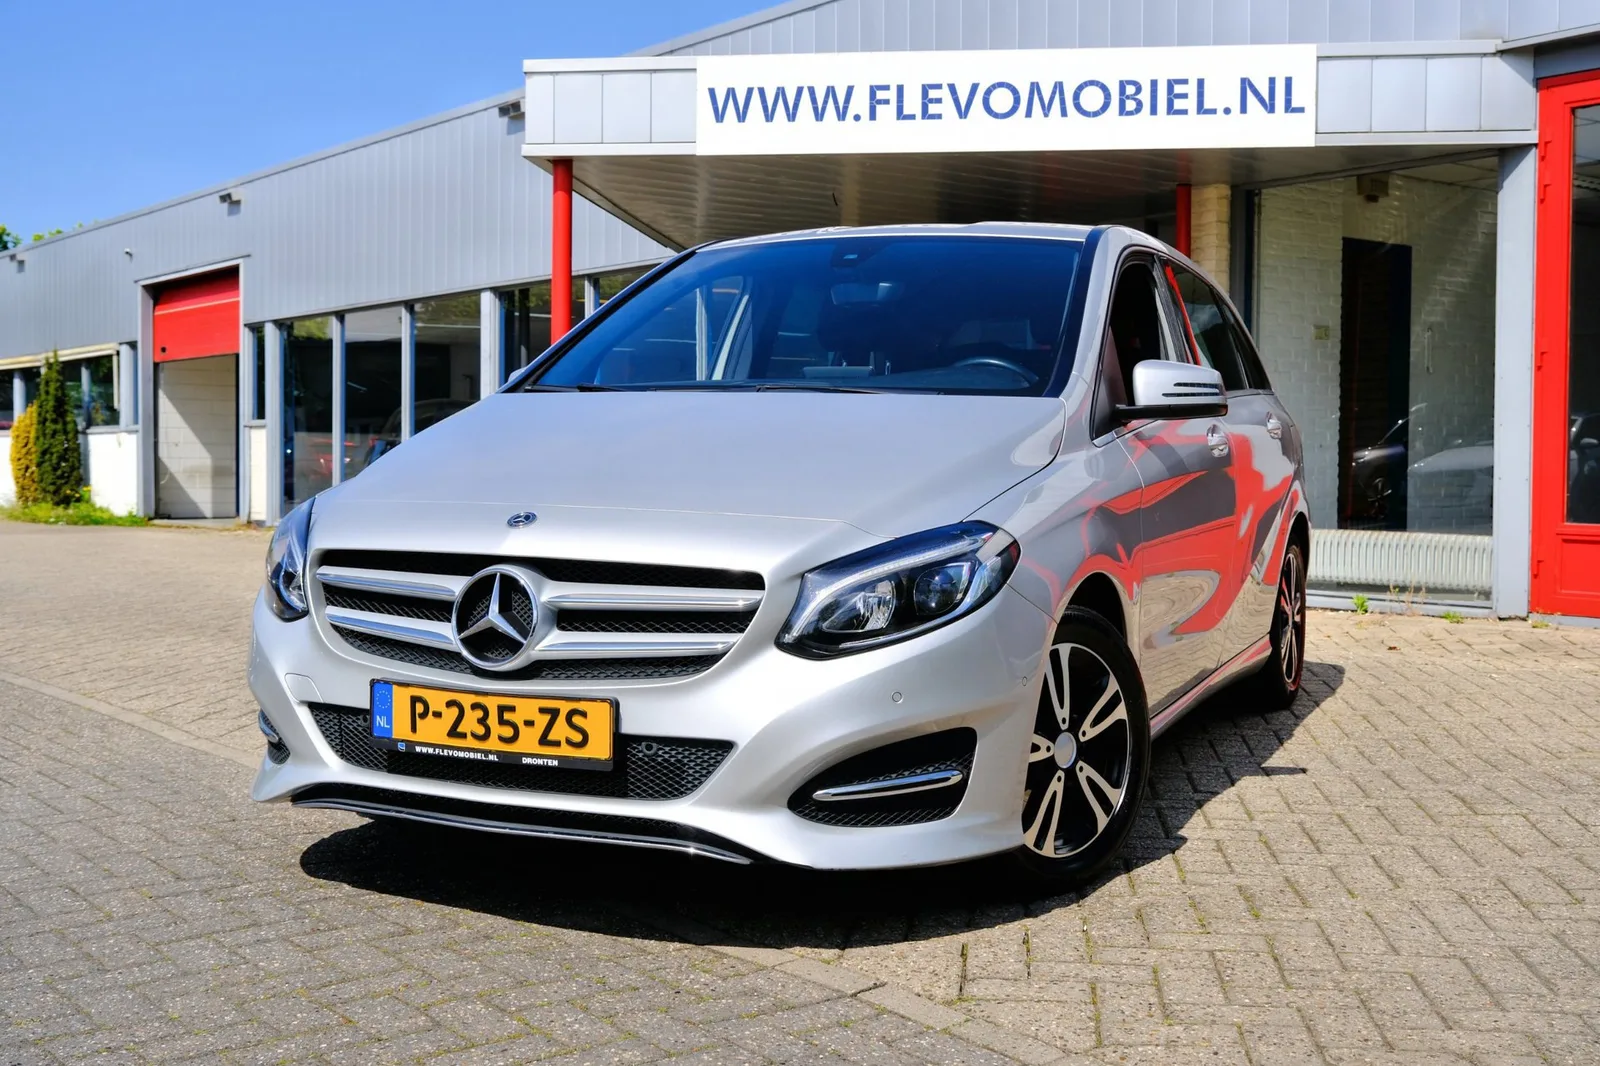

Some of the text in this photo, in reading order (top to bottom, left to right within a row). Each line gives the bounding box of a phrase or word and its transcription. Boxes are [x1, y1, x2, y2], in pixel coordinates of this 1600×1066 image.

[707, 76, 1305, 124] WWW.FLEVOMOBIEL.NL
[376, 715, 390, 728] NL
[409, 694, 590, 749] P-235-ZS
[415, 745, 559, 766] WWW.FLEVOMOBIEL.NL DRONTEN
